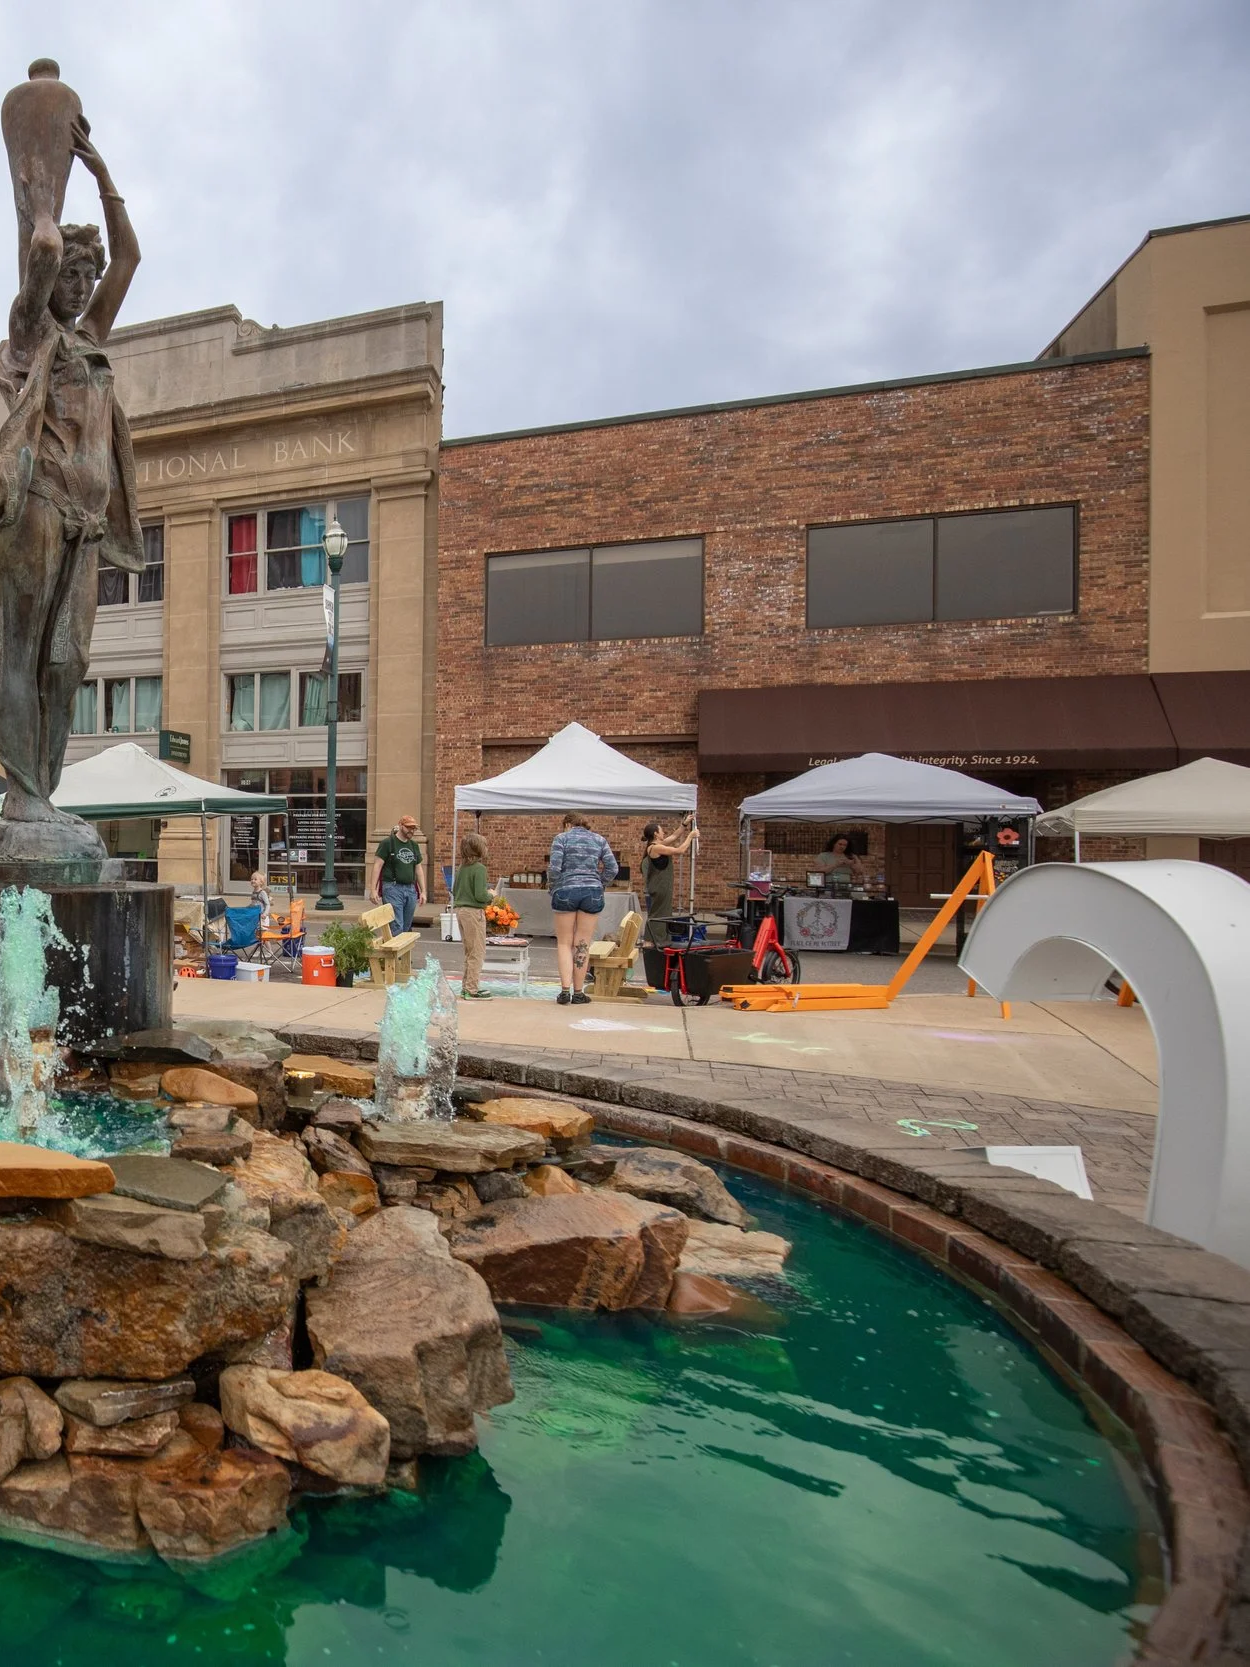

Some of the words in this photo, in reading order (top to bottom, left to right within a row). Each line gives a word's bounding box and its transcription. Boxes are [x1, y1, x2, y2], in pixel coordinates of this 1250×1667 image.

[136, 447, 247, 484] TIONAL
[274, 431, 354, 464] BANK
[918, 755, 968, 767] integrity.
[971, 755, 1001, 764] Since
[1005, 755, 1039, 765] 1924.
